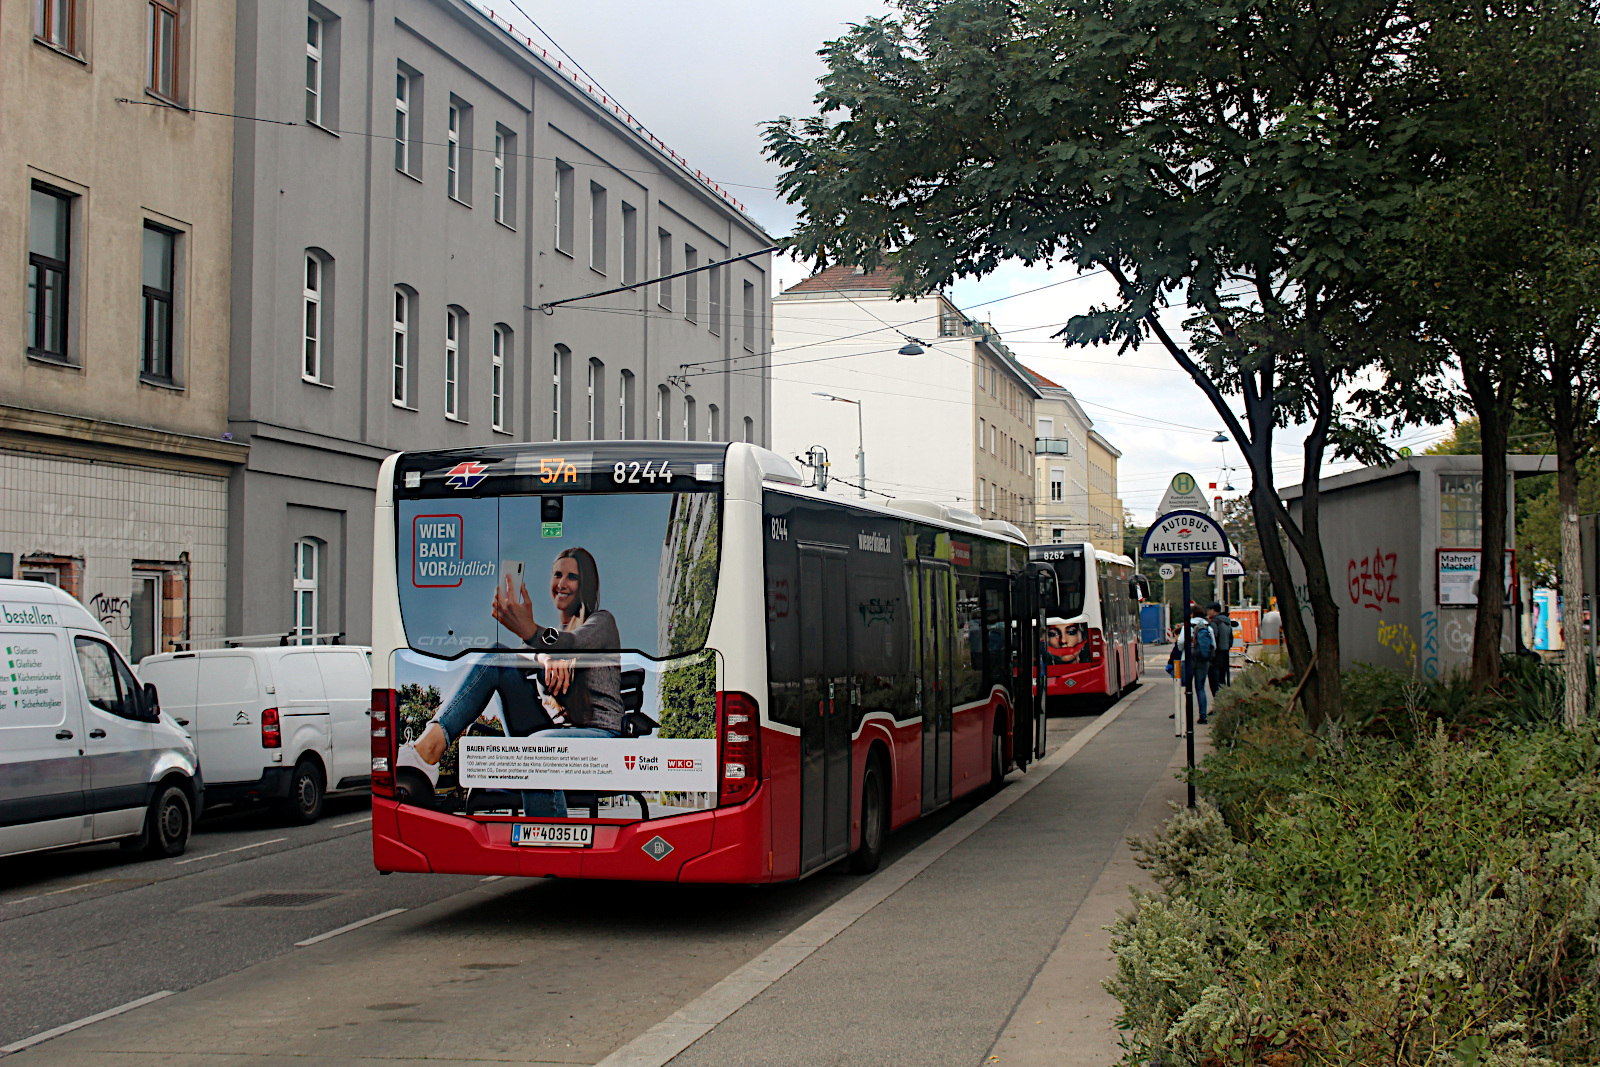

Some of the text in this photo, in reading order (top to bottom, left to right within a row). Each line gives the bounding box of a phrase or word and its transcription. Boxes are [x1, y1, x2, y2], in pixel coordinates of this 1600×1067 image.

[540, 458, 577, 484] 57A
[613, 460, 673, 484] 8244
[1178, 477, 1189, 490] H
[419, 523, 456, 539] WIEN
[771, 517, 788, 541] 8244
[1161, 517, 1209, 534] AUTOBUS
[419, 542, 457, 558] BAUT
[1153, 541, 1218, 552] HALTESTELLE
[1043, 551, 1065, 560] 8262
[1441, 555, 1476, 563] Mahrer?
[1441, 562, 1476, 570] Macher!
[2, 604, 58, 625] bestellen.
[417, 635, 489, 647] CITARO
[466, 745, 485, 753] BAUEN
[486, 745, 501, 753] FÜRS
[537, 745, 556, 753] BLÜHT
[557, 746, 569, 754] AUF.
[639, 755, 659, 763] Stadt
[668, 759, 694, 768] WKO
[638, 763, 659, 771] Wien
[523, 827, 532, 840] W
